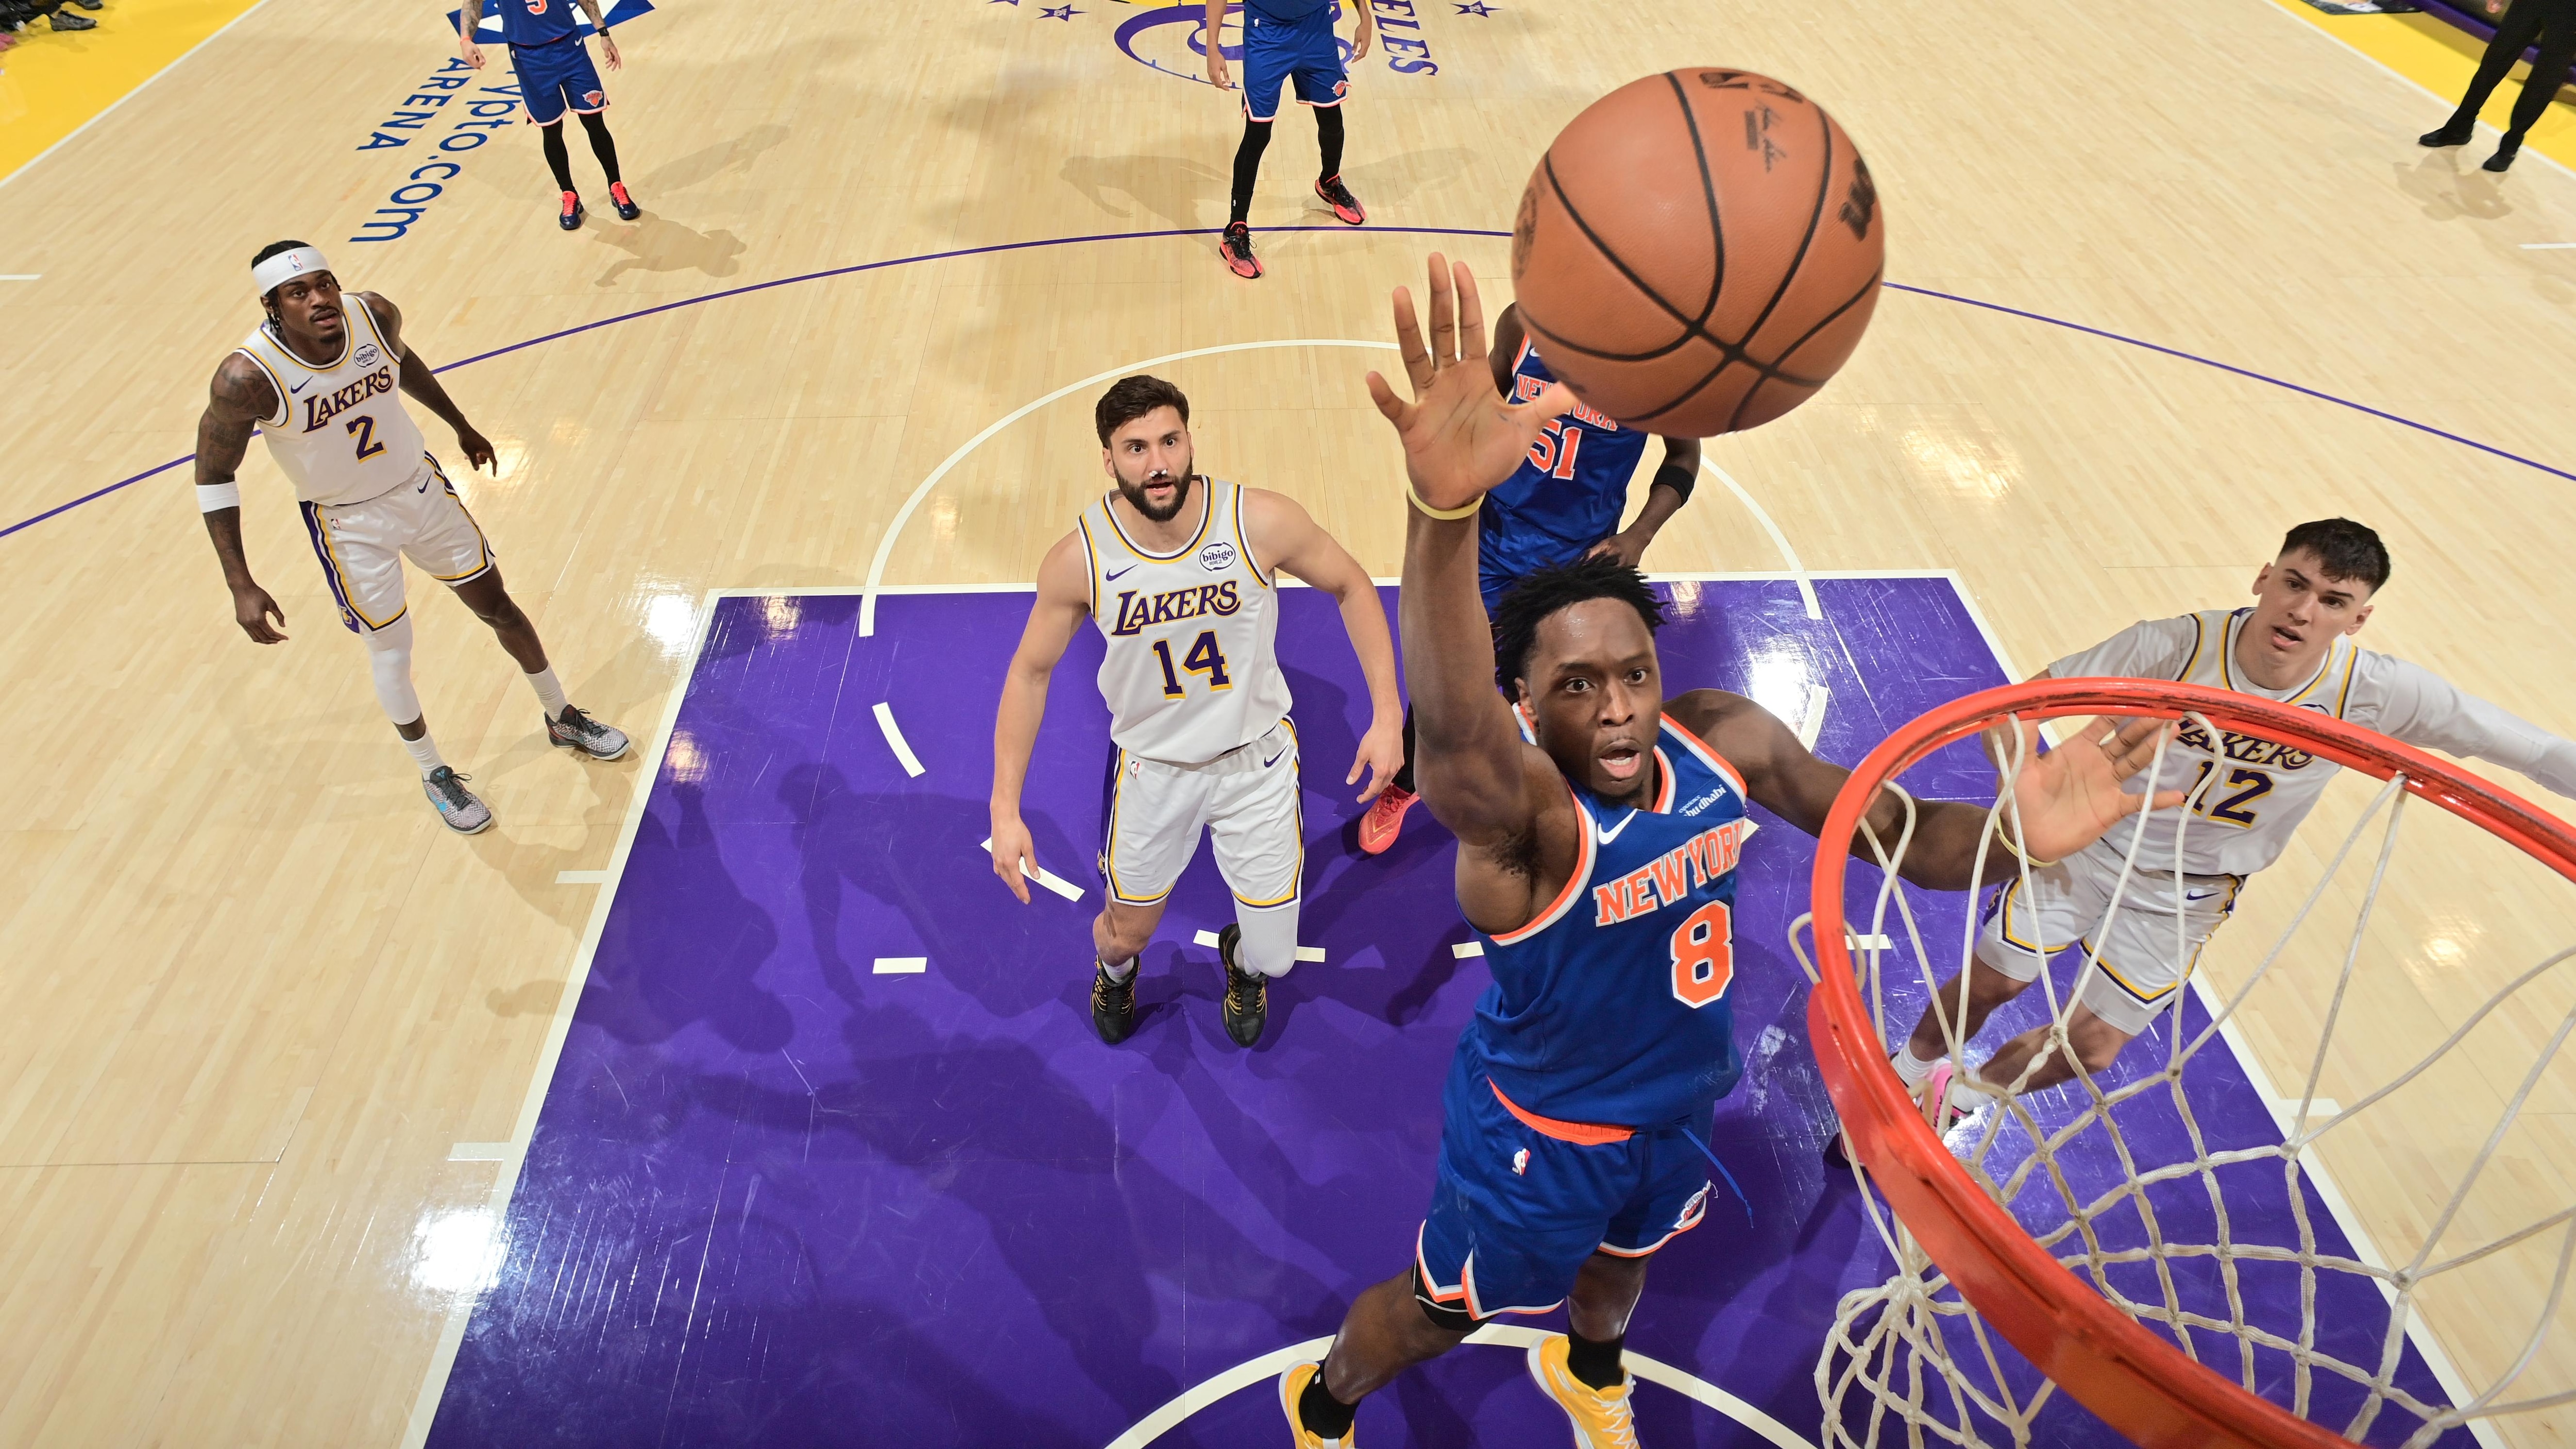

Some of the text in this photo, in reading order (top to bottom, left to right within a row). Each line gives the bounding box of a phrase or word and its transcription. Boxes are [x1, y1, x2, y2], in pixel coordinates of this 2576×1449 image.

[355, 57, 475, 150] ARENA
[348, 71, 522, 242] ypto.com
[355, 348, 377, 362] bibigo
[302, 365, 395, 433] LAKERS
[1564, 401, 1618, 432] ORK
[346, 415, 387, 464] 2
[1527, 418, 1582, 481] 51
[1202, 550, 1233, 561] bibigo
[1110, 579, 1241, 637] LAKERS
[1152, 629, 1232, 700] 14
[1684, 784, 1726, 816] bu dhabi
[2179, 760, 2276, 830] 12
[1592, 844, 1687, 927] NEW
[1670, 900, 1734, 1009] 8
